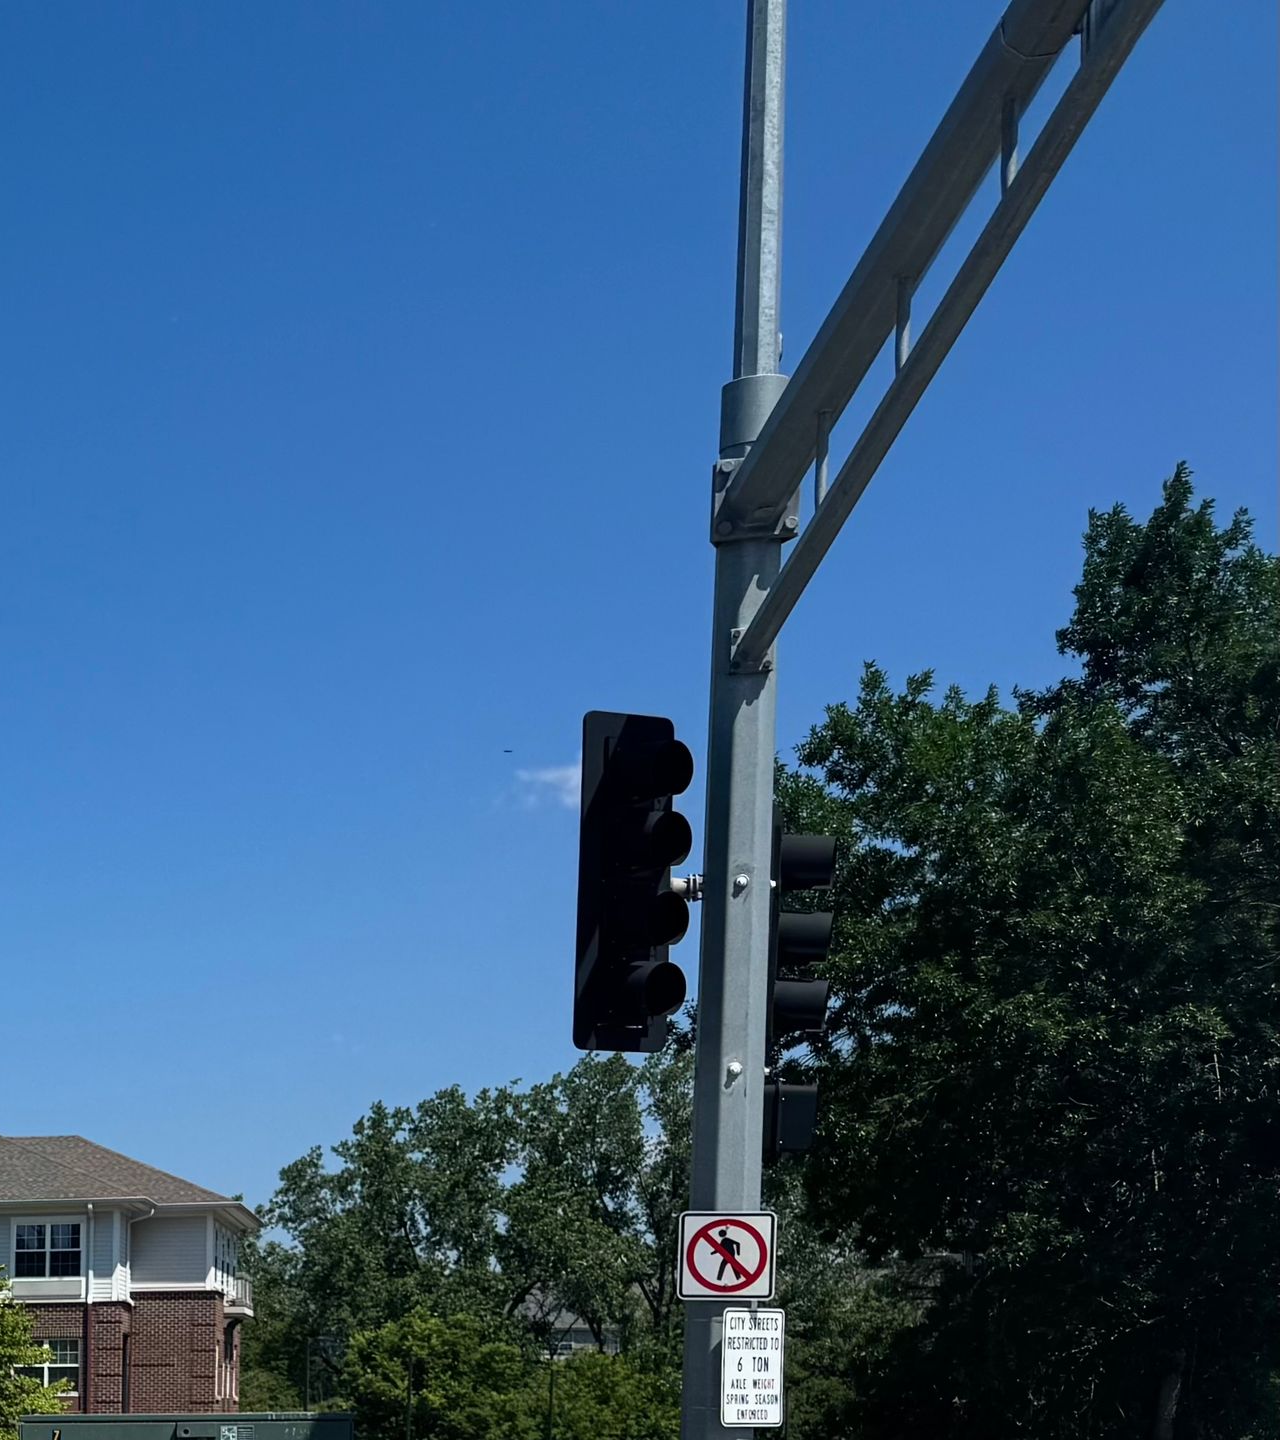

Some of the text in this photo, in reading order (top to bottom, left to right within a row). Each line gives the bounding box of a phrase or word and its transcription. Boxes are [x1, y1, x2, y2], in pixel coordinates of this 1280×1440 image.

[729, 1316, 779, 1331] CITY STREETS
[727, 1336, 779, 1351] RESTRICTED TO
[737, 1356, 769, 1372] 6 TON
[730, 1378, 775, 1390] AXLE WEIGHT
[726, 1393, 779, 1405] SPRING SEASON
[736, 1408, 768, 1420] ENFORCED
